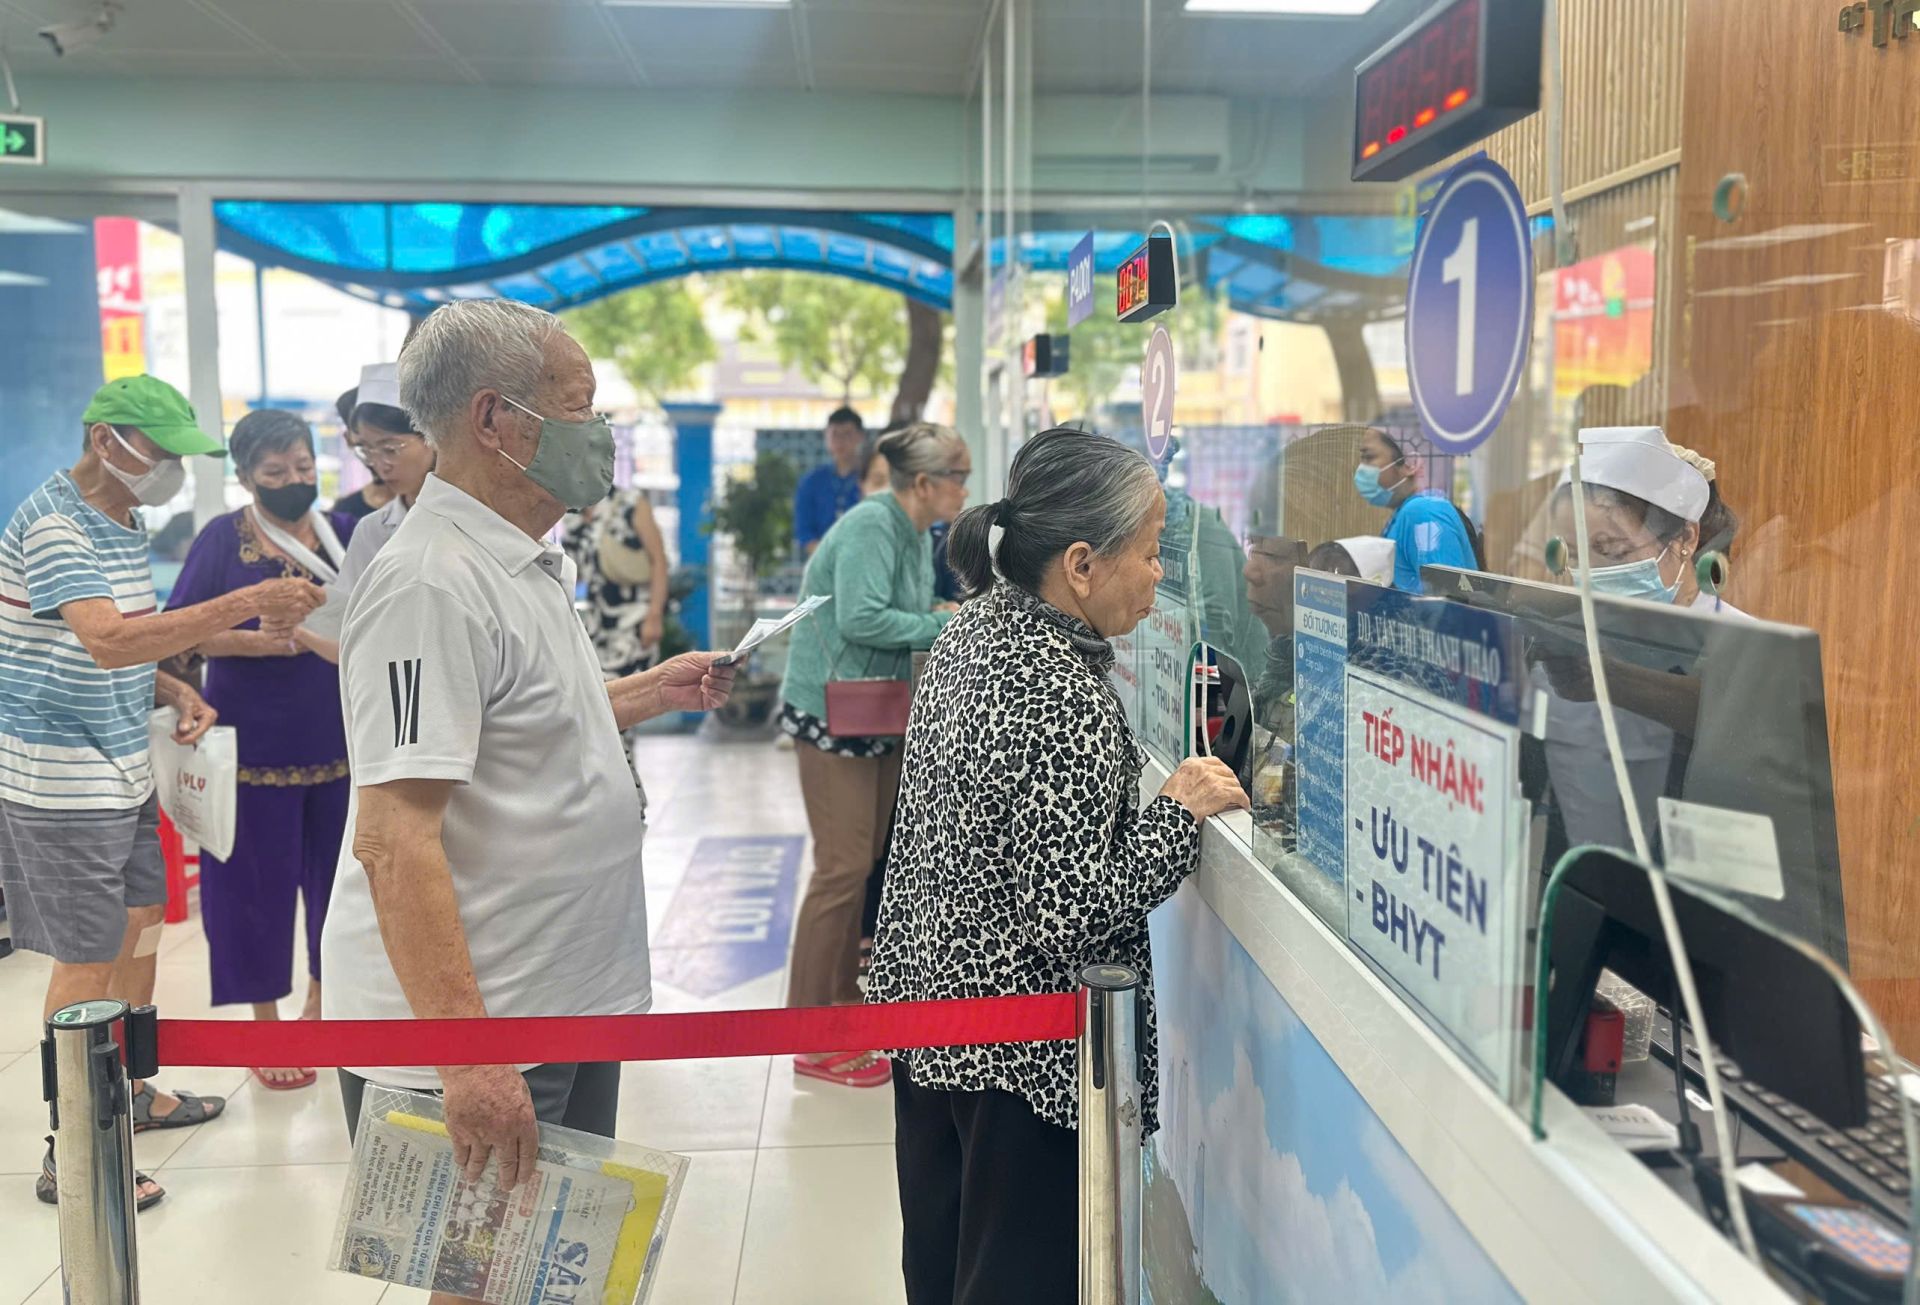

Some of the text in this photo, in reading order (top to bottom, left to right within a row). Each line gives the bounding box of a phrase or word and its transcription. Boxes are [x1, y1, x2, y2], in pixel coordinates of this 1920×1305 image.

[1442, 217, 1479, 396] 1
[1151, 351, 1166, 437] 2
[1155, 647, 1172, 678] DỊCH
[1173, 659, 1182, 692] VỤ
[1462, 629, 1500, 687] THẢO
[1156, 684, 1170, 715] THU
[1171, 690, 1182, 726] PHÍ
[1156, 726, 1181, 766] ONLINE
[1362, 707, 1484, 815] TIẾP NHẬN:
[1371, 806, 1408, 874] ƯU
[1417, 836, 1487, 935] TIÊN
[1372, 879, 1445, 981] BHYT
[385, 1252, 401, 1281] Chung
